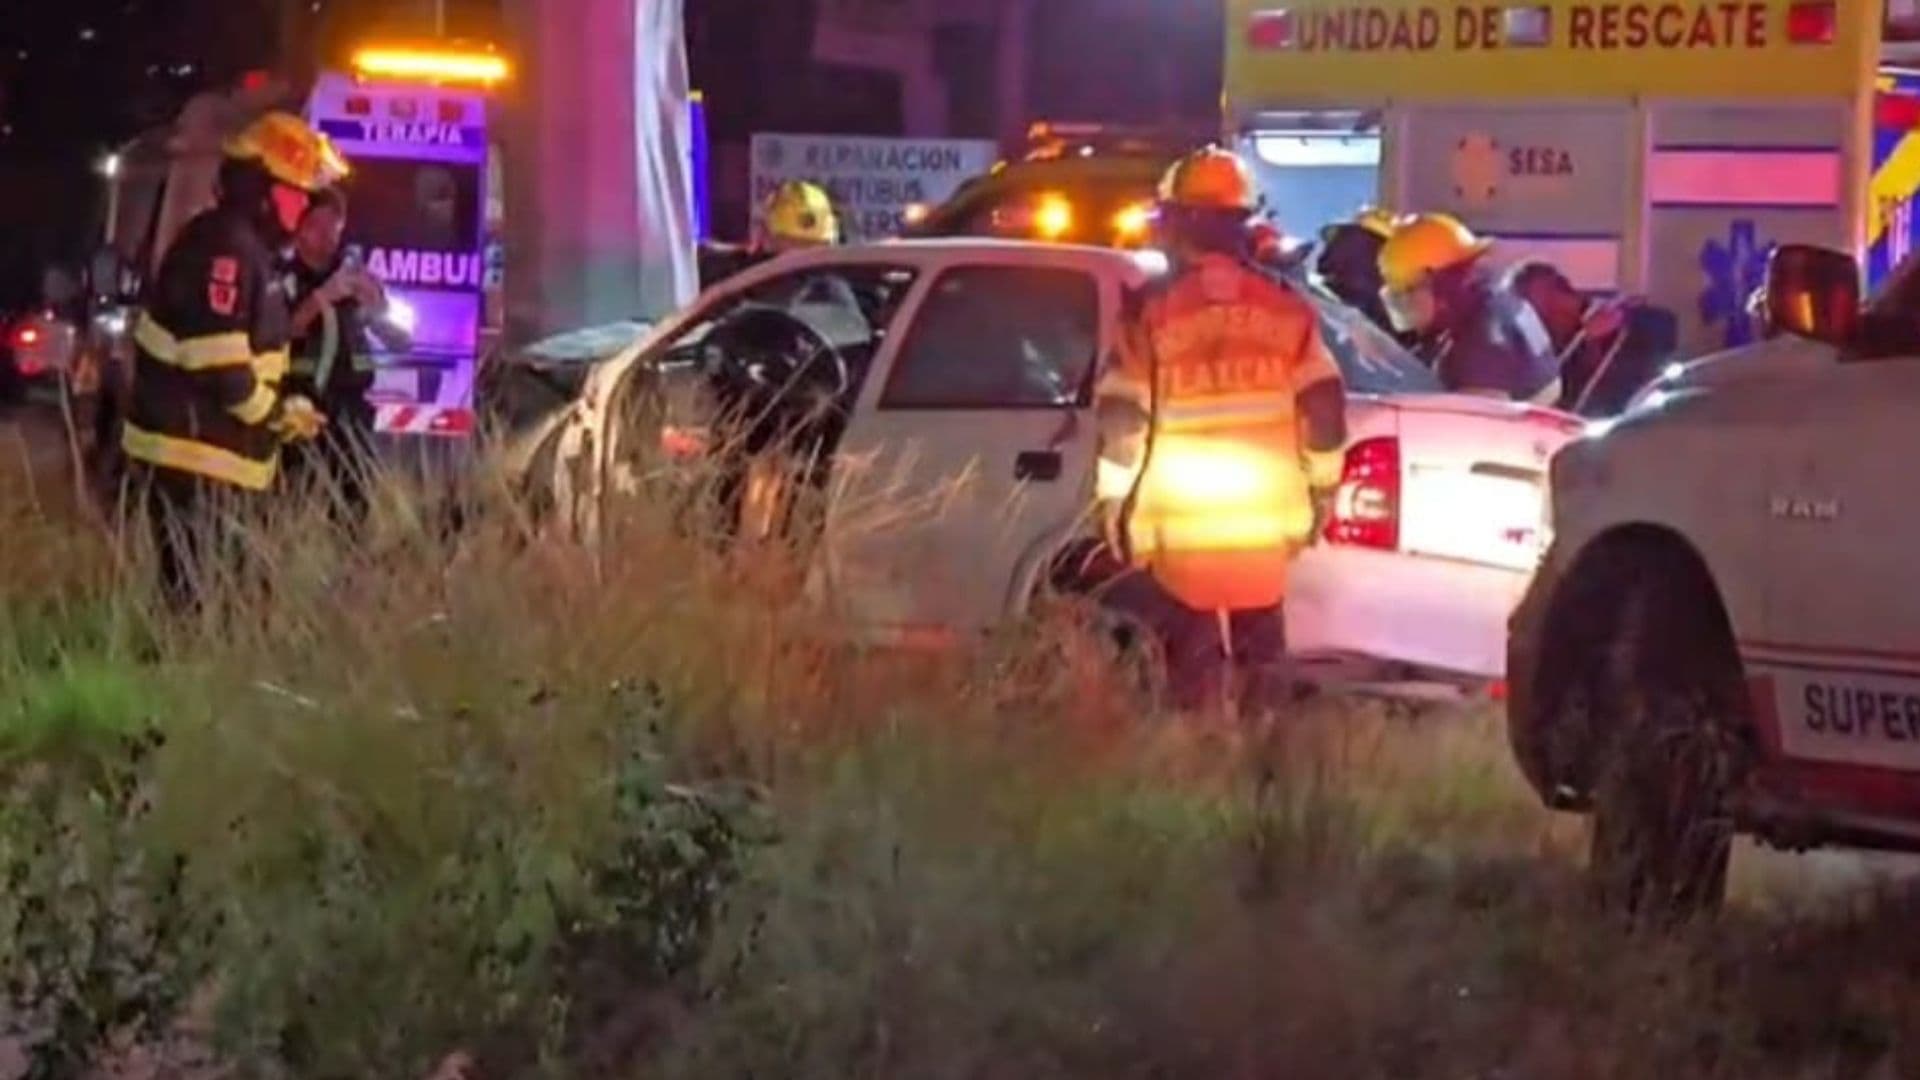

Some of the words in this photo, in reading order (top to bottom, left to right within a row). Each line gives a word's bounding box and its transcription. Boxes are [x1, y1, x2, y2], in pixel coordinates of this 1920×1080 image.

[1297, 8, 1439, 50] UNIDAD
[1455, 7, 1499, 49] DE
[1569, 4, 1766, 49] RESCATE
[360, 121, 463, 145] TERAPIA
[1509, 147, 1573, 176] SESA
[1770, 498, 1840, 518] RAM
